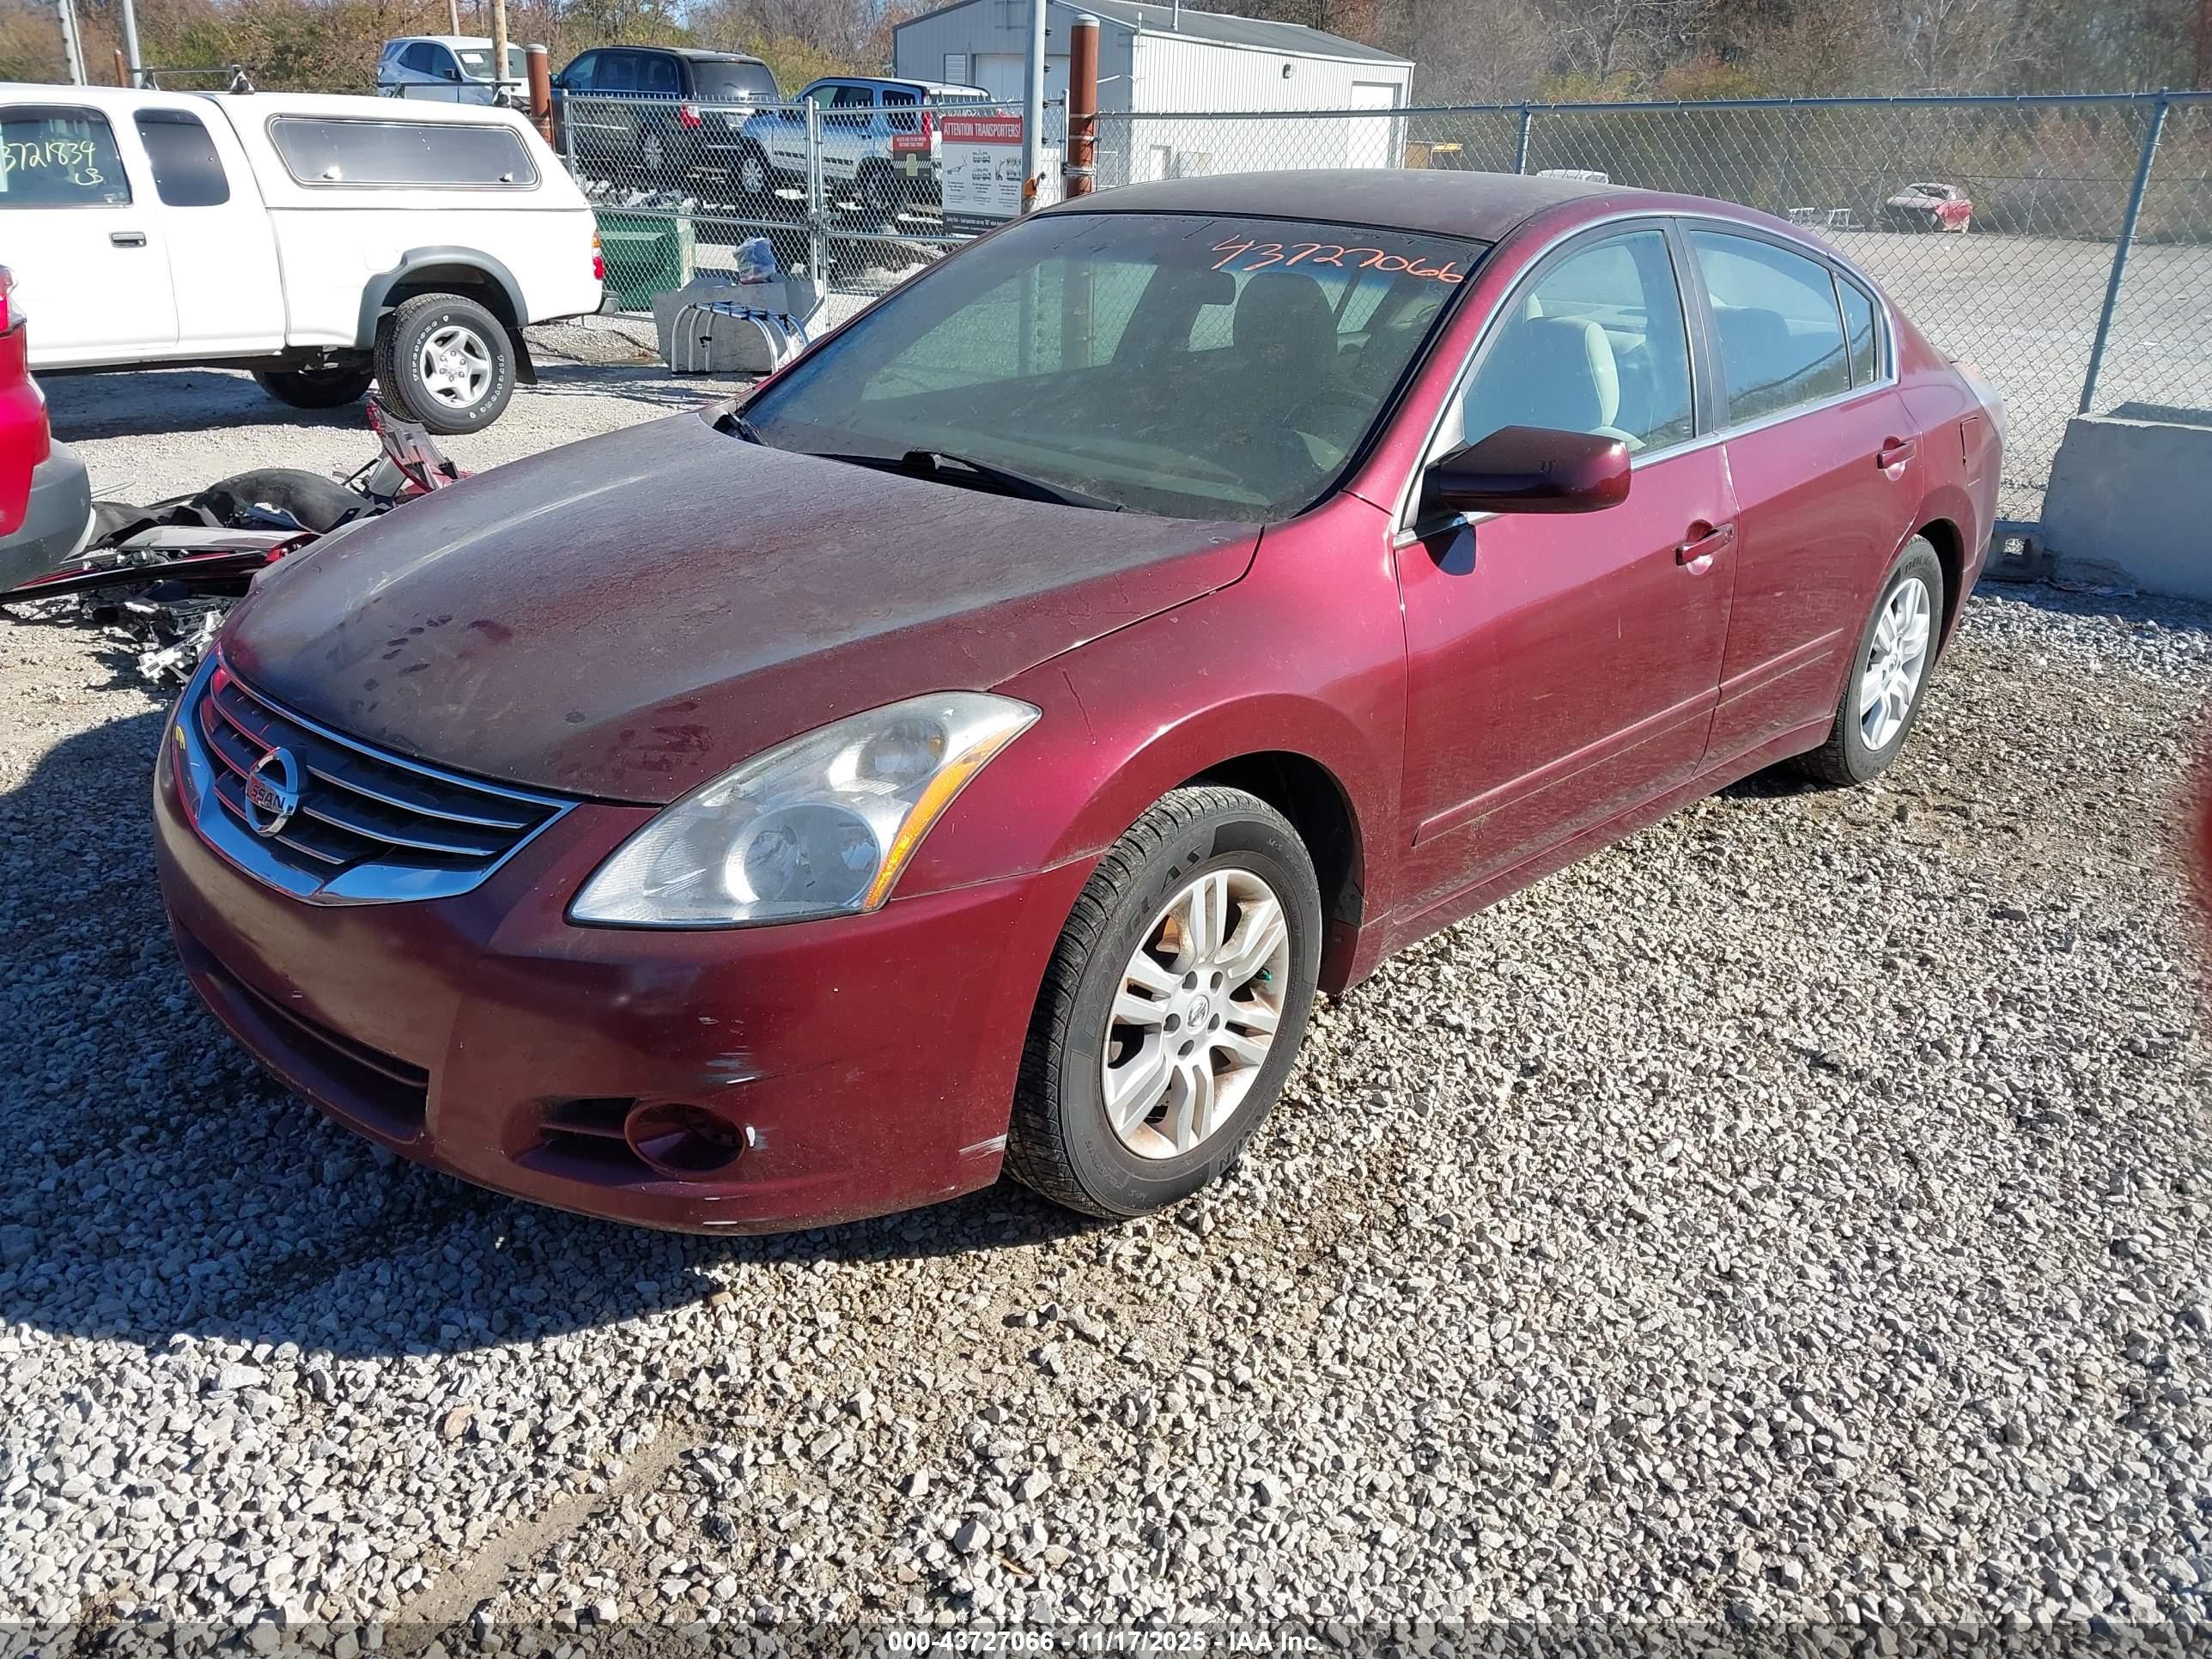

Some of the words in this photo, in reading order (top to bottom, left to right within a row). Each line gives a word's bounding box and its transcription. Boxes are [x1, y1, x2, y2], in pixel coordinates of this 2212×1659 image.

[945, 123, 973, 137] ATTENTION
[975, 123, 1021, 138] TRANSPORTERS!
[1211, 234, 1464, 283] 43727066
